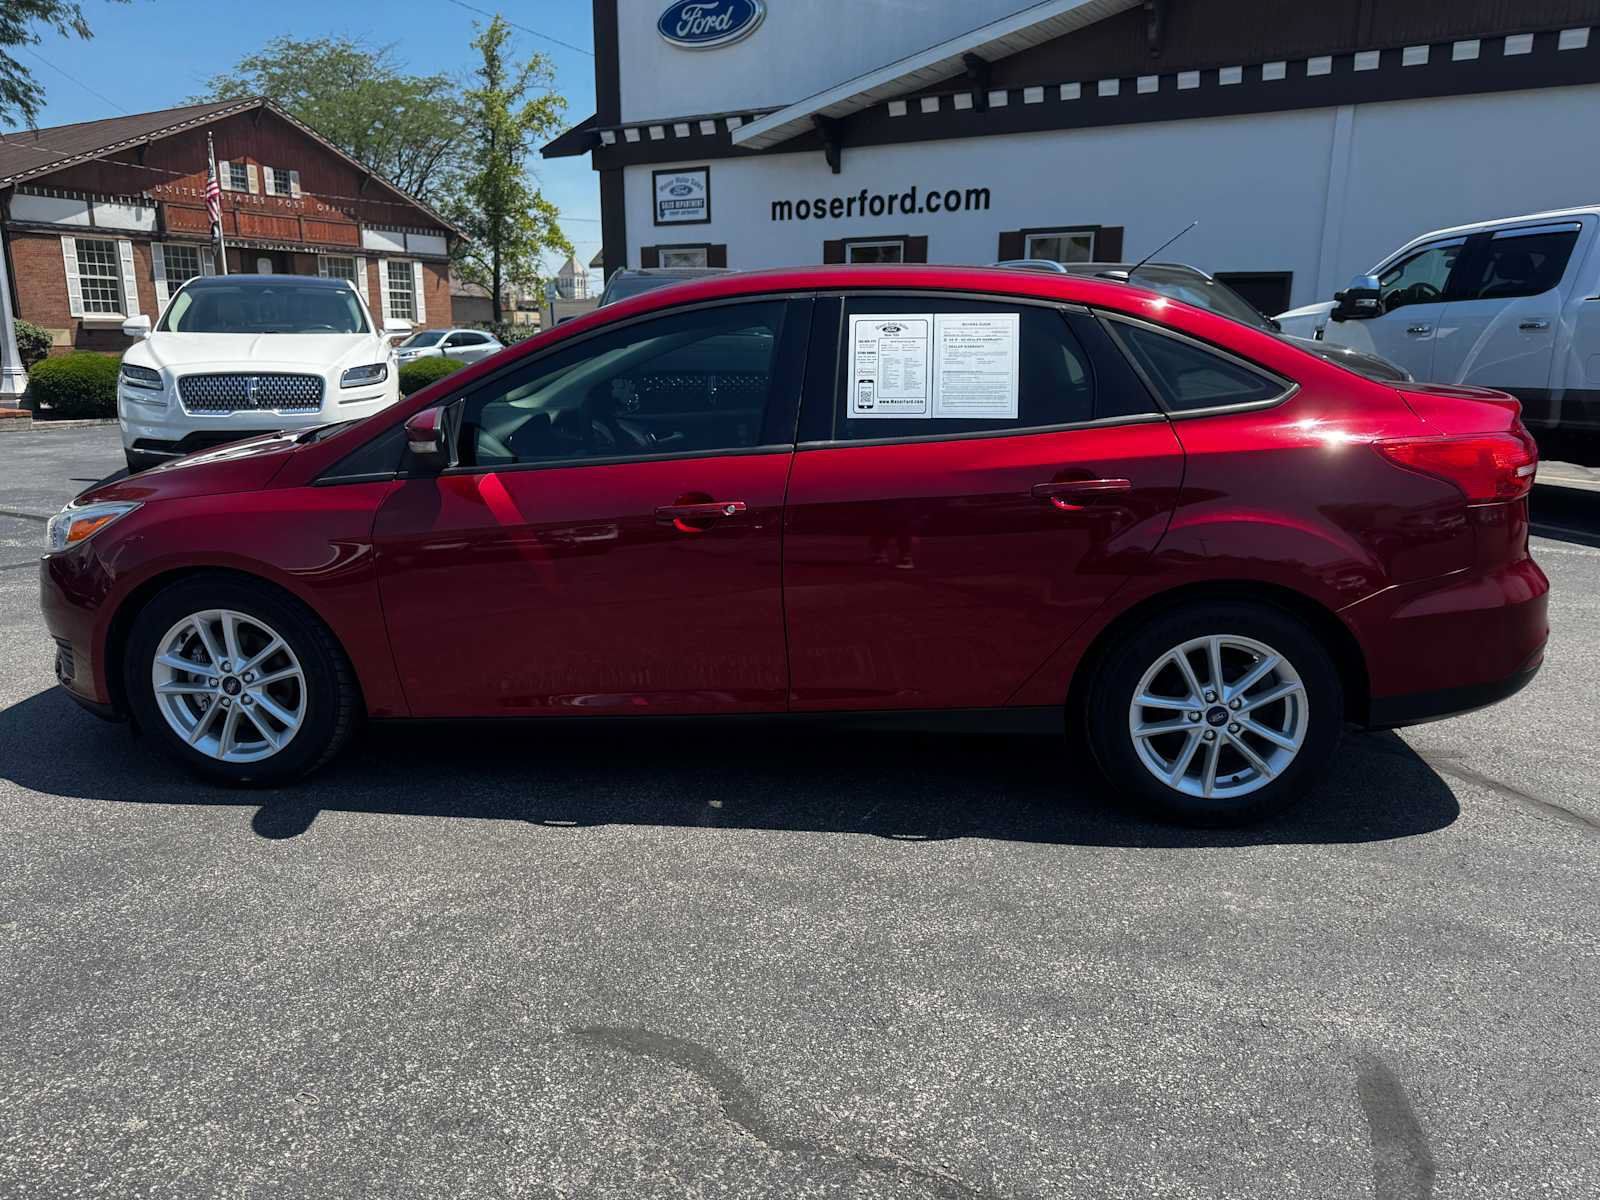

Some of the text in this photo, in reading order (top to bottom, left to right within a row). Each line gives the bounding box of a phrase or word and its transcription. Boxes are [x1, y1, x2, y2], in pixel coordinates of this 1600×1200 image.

[675, 1, 734, 37] Ford
[155, 184, 206, 198] UNITED
[278, 198, 305, 209] POST
[771, 186, 991, 221] moserford.com
